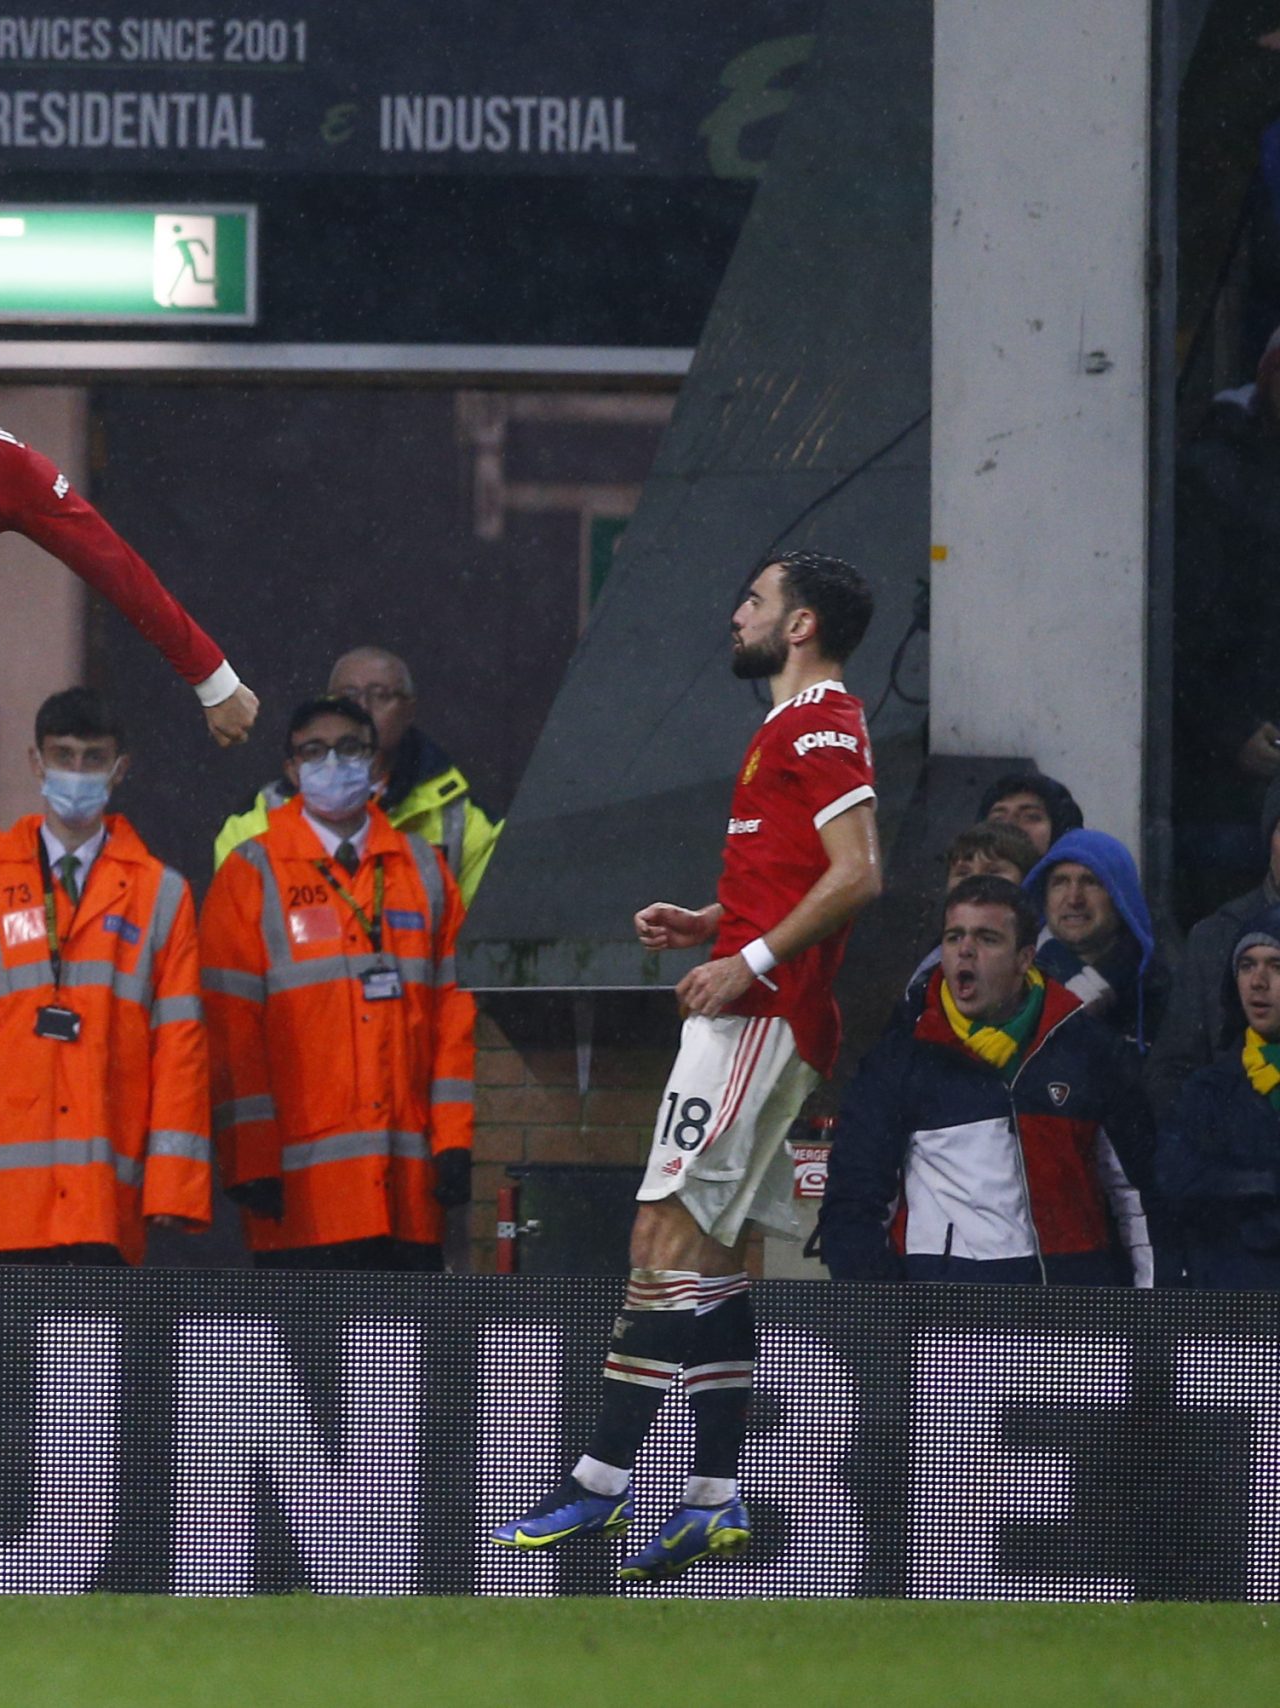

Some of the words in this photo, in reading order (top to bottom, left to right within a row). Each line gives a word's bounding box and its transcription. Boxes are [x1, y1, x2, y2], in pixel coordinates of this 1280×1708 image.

[121, 19, 214, 61] SINCE
[224, 20, 308, 62] 2001
[380, 96, 636, 153] INDUSTRIAL
[793, 730, 859, 756] KOHLER
[3, 884, 33, 907] 73
[288, 885, 329, 907] 205
[659, 1091, 712, 1152] 18
